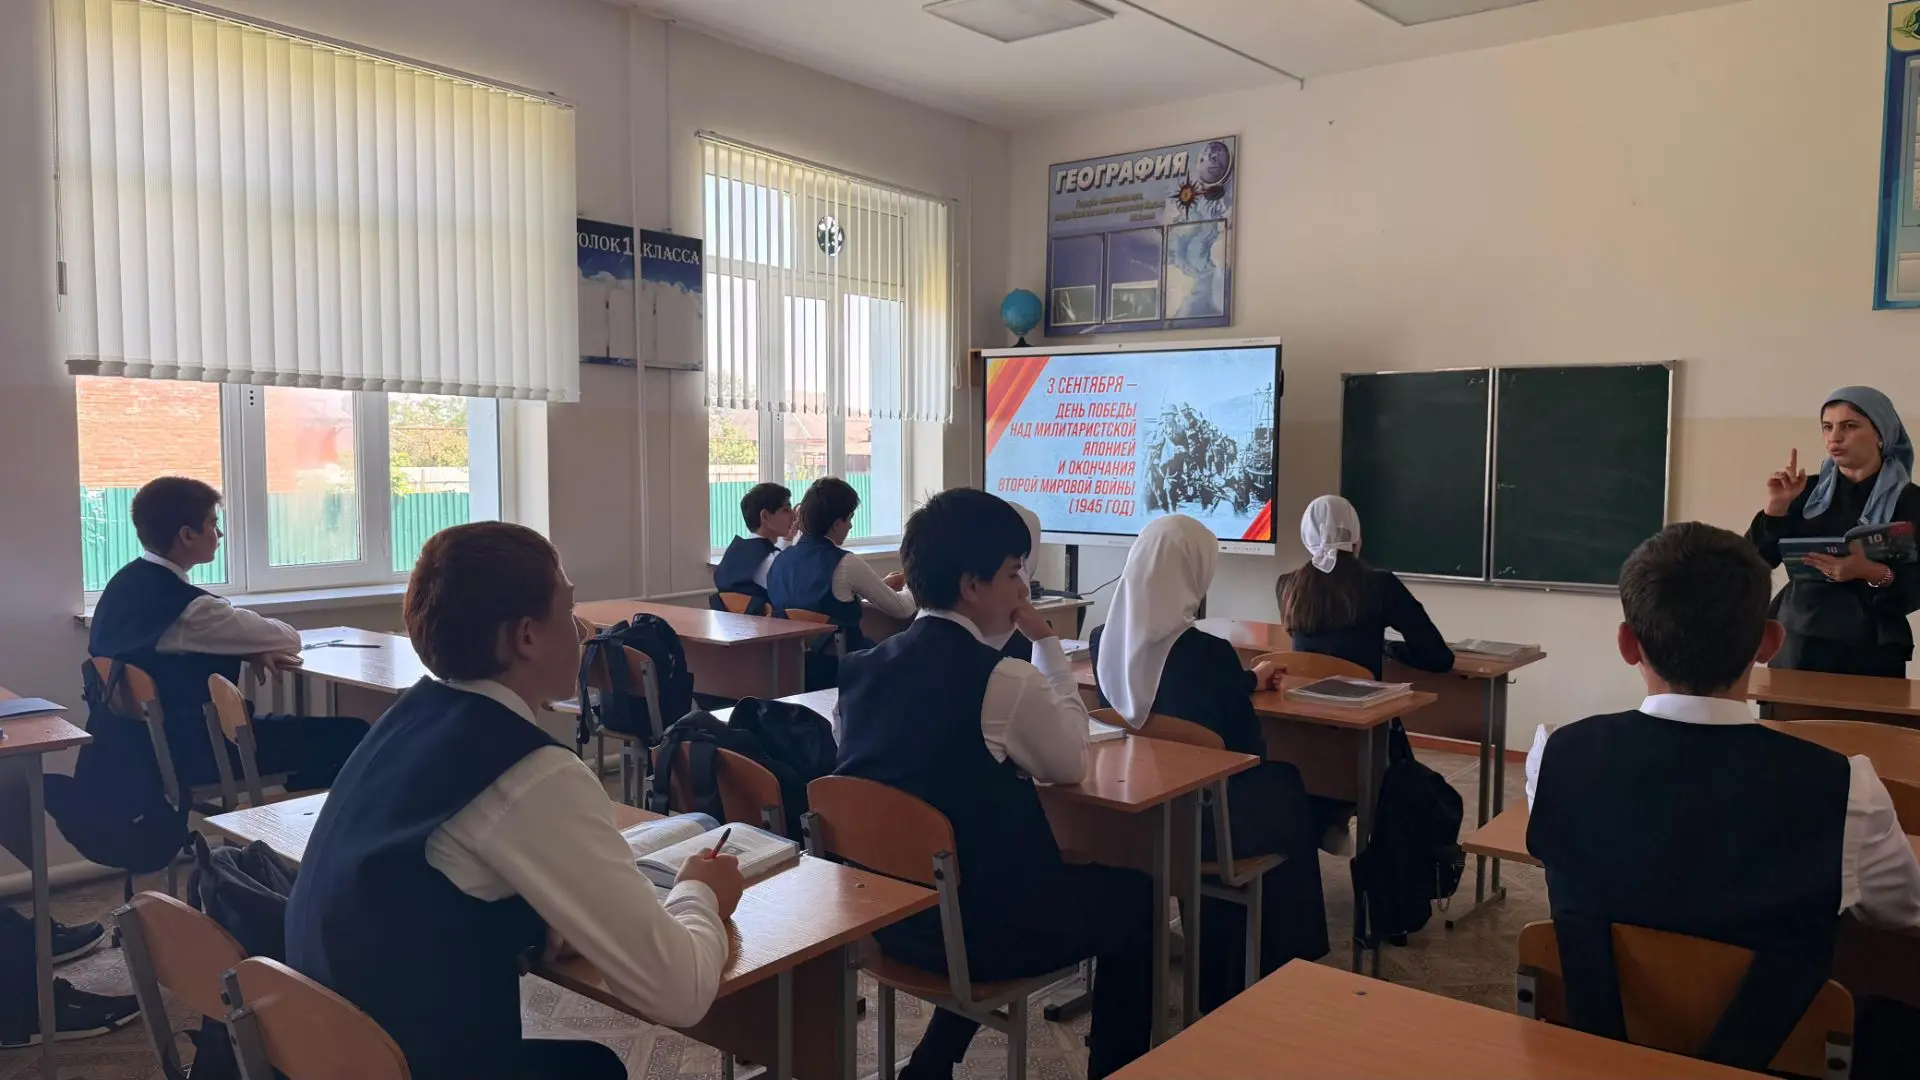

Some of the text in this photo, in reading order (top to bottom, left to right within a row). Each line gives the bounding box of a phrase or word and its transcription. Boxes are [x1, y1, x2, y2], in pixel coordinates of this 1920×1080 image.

[1055, 151, 1189, 194] ГЕОГРАФИЯ
[577, 232, 620, 253] ОЛОК
[643, 243, 700, 265] КЛАССА
[1047, 377, 1055, 394] 3
[1058, 375, 1124, 394] СЕНТЯБРЯ
[1056, 402, 1137, 419] ДЕНЬ ПОБЕДЫ
[1010, 419, 1137, 438] НАД МИЛИТАРИСТСКОЙ
[1083, 439, 1135, 457] ЯПОНИЕЙ
[1058, 461, 1135, 475] И ОКОНЧАНИЯ
[998, 475, 1135, 495] ВТОРОЙ МИРОВОЙ ВОЙНЫ
[1069, 499, 1135, 516] (1945 ГОД)
[1868, 533, 1883, 544] 10
